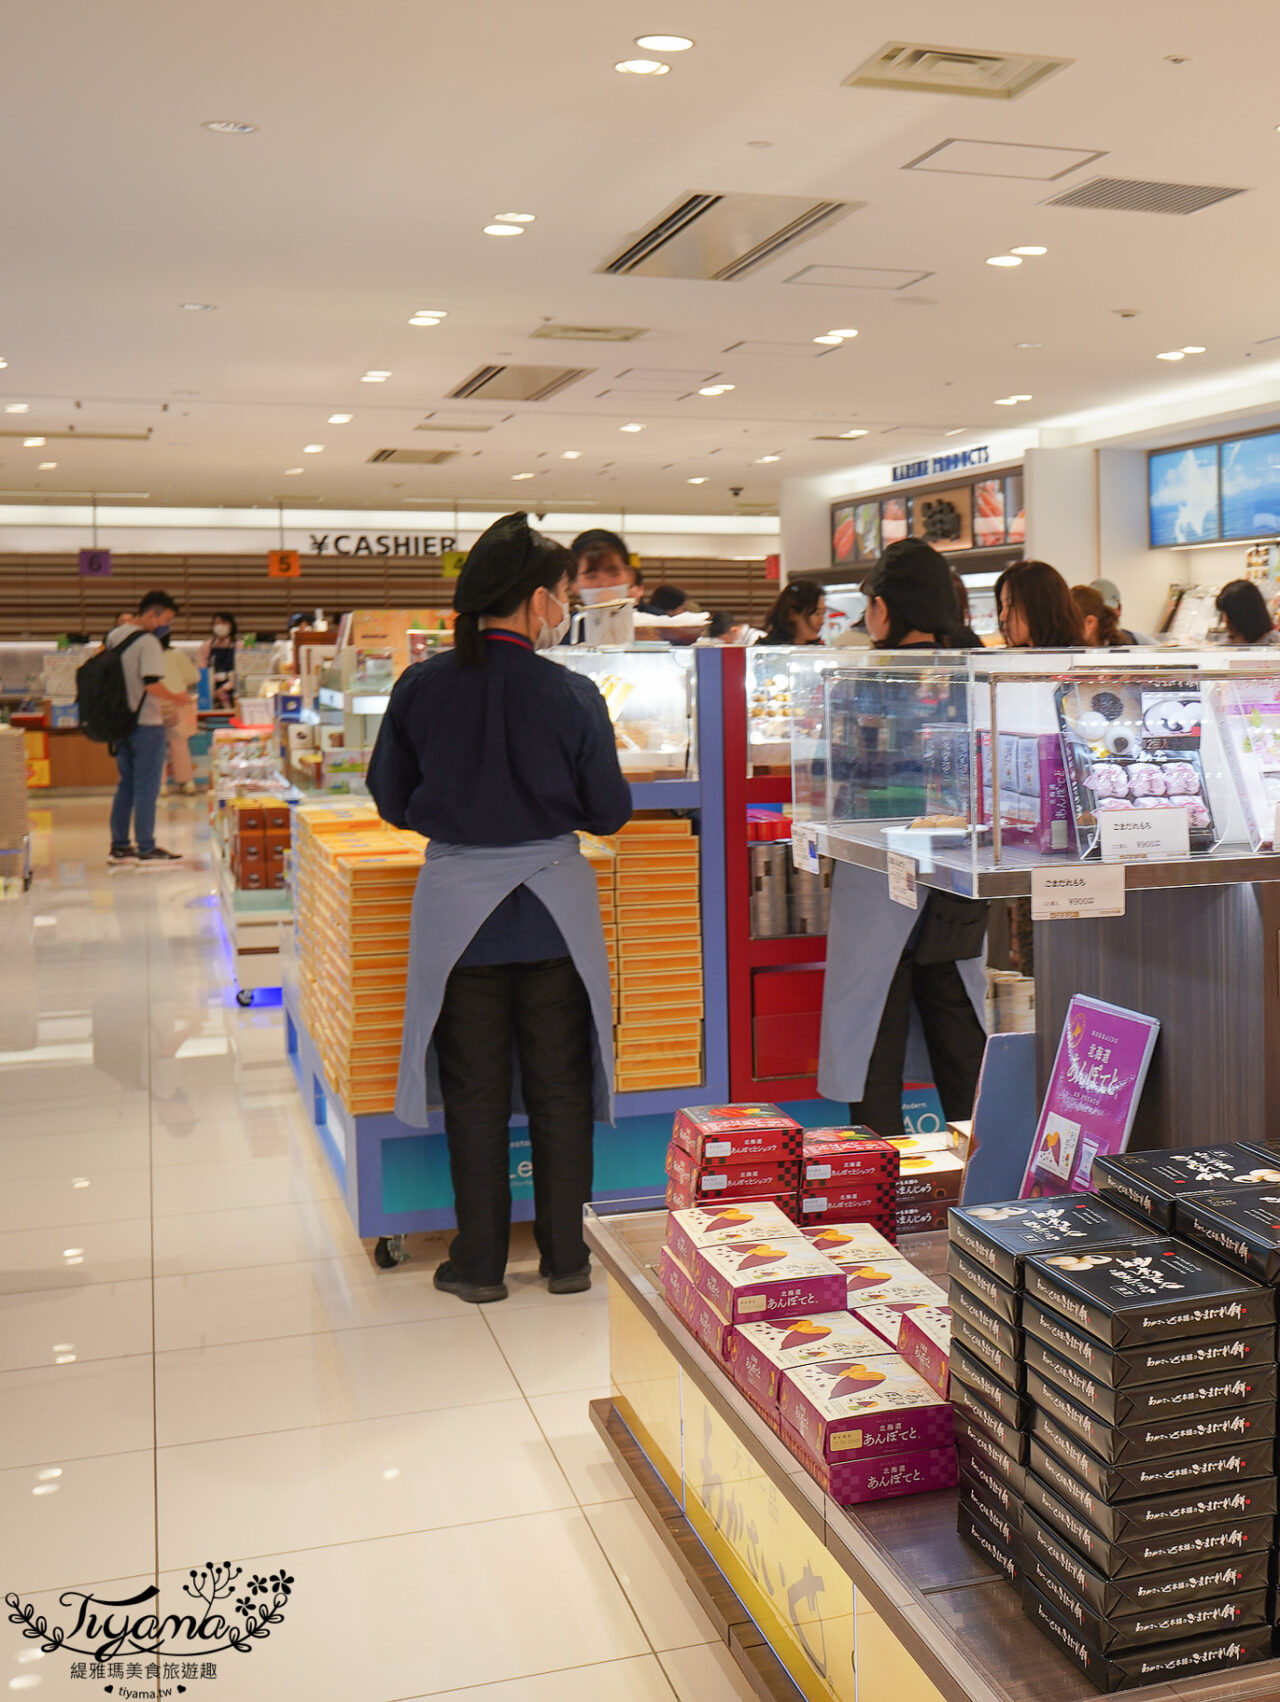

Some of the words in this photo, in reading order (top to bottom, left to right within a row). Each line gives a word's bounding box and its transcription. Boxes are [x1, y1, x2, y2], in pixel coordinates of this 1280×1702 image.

[88, 554, 102, 572] 6
[277, 556, 291, 573] 5
[780, 1288, 802, 1297] 北海道
[767, 1293, 815, 1310] あんぽてと
[879, 1421, 902, 1432] 北海道
[863, 1426, 917, 1446] あんぽてと
[883, 1464, 906, 1475] 北海道
[867, 1469, 921, 1490] あんぽてと
